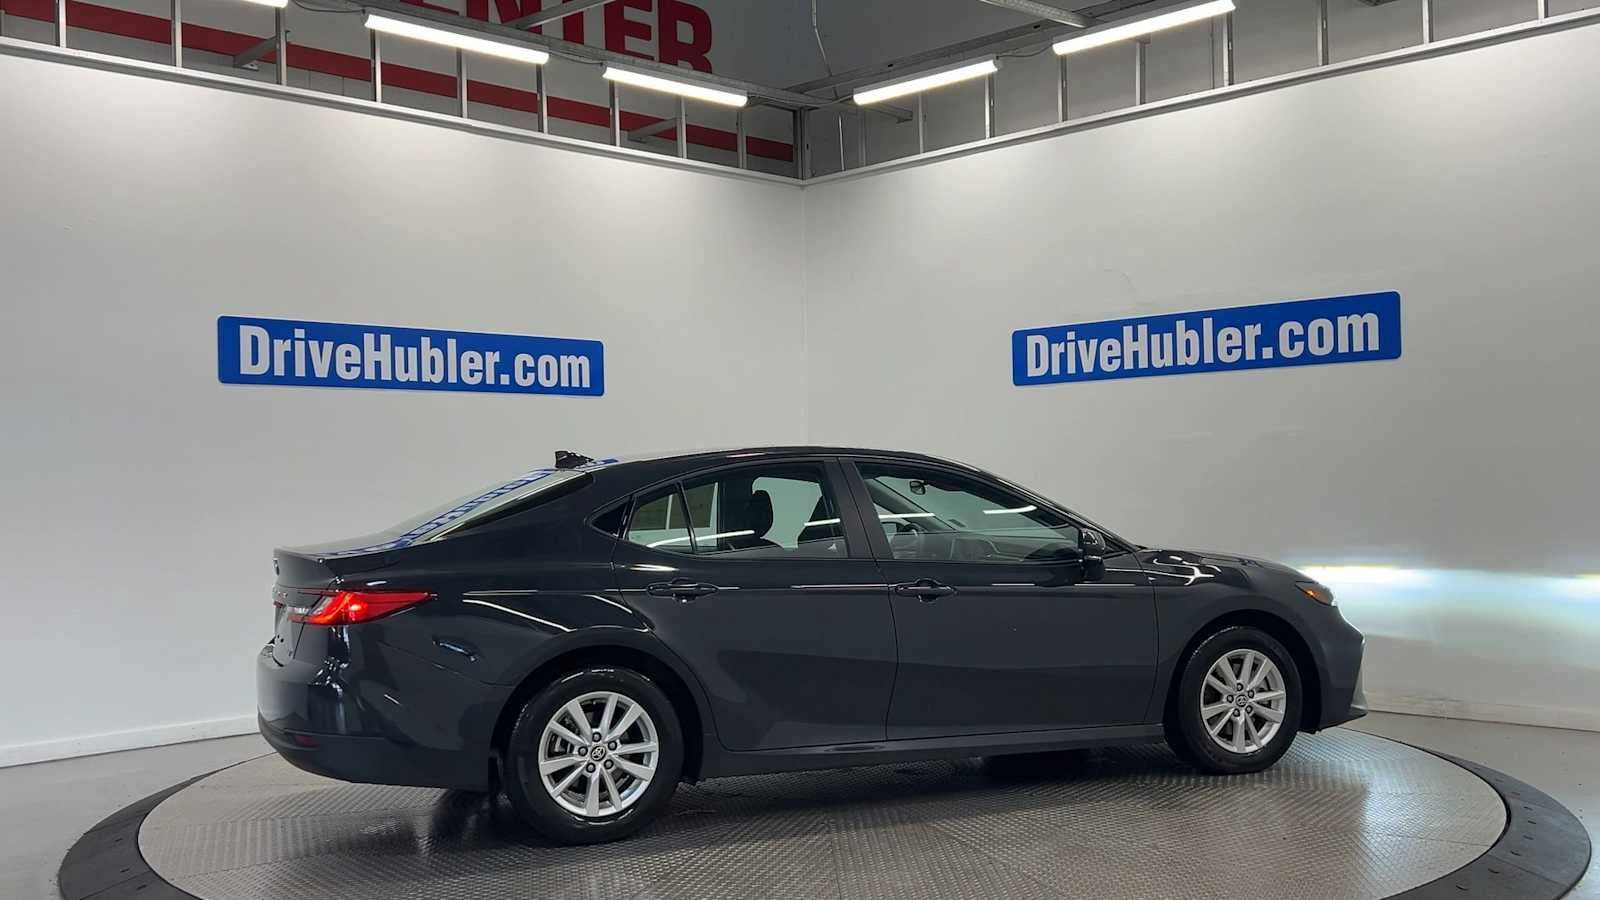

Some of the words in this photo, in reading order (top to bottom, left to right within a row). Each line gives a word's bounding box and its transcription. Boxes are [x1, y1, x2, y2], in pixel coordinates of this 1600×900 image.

[403, 0, 713, 74] NER
[239, 324, 591, 388] DriveHubler.com
[1026, 311, 1380, 377] DriveHubler.com
